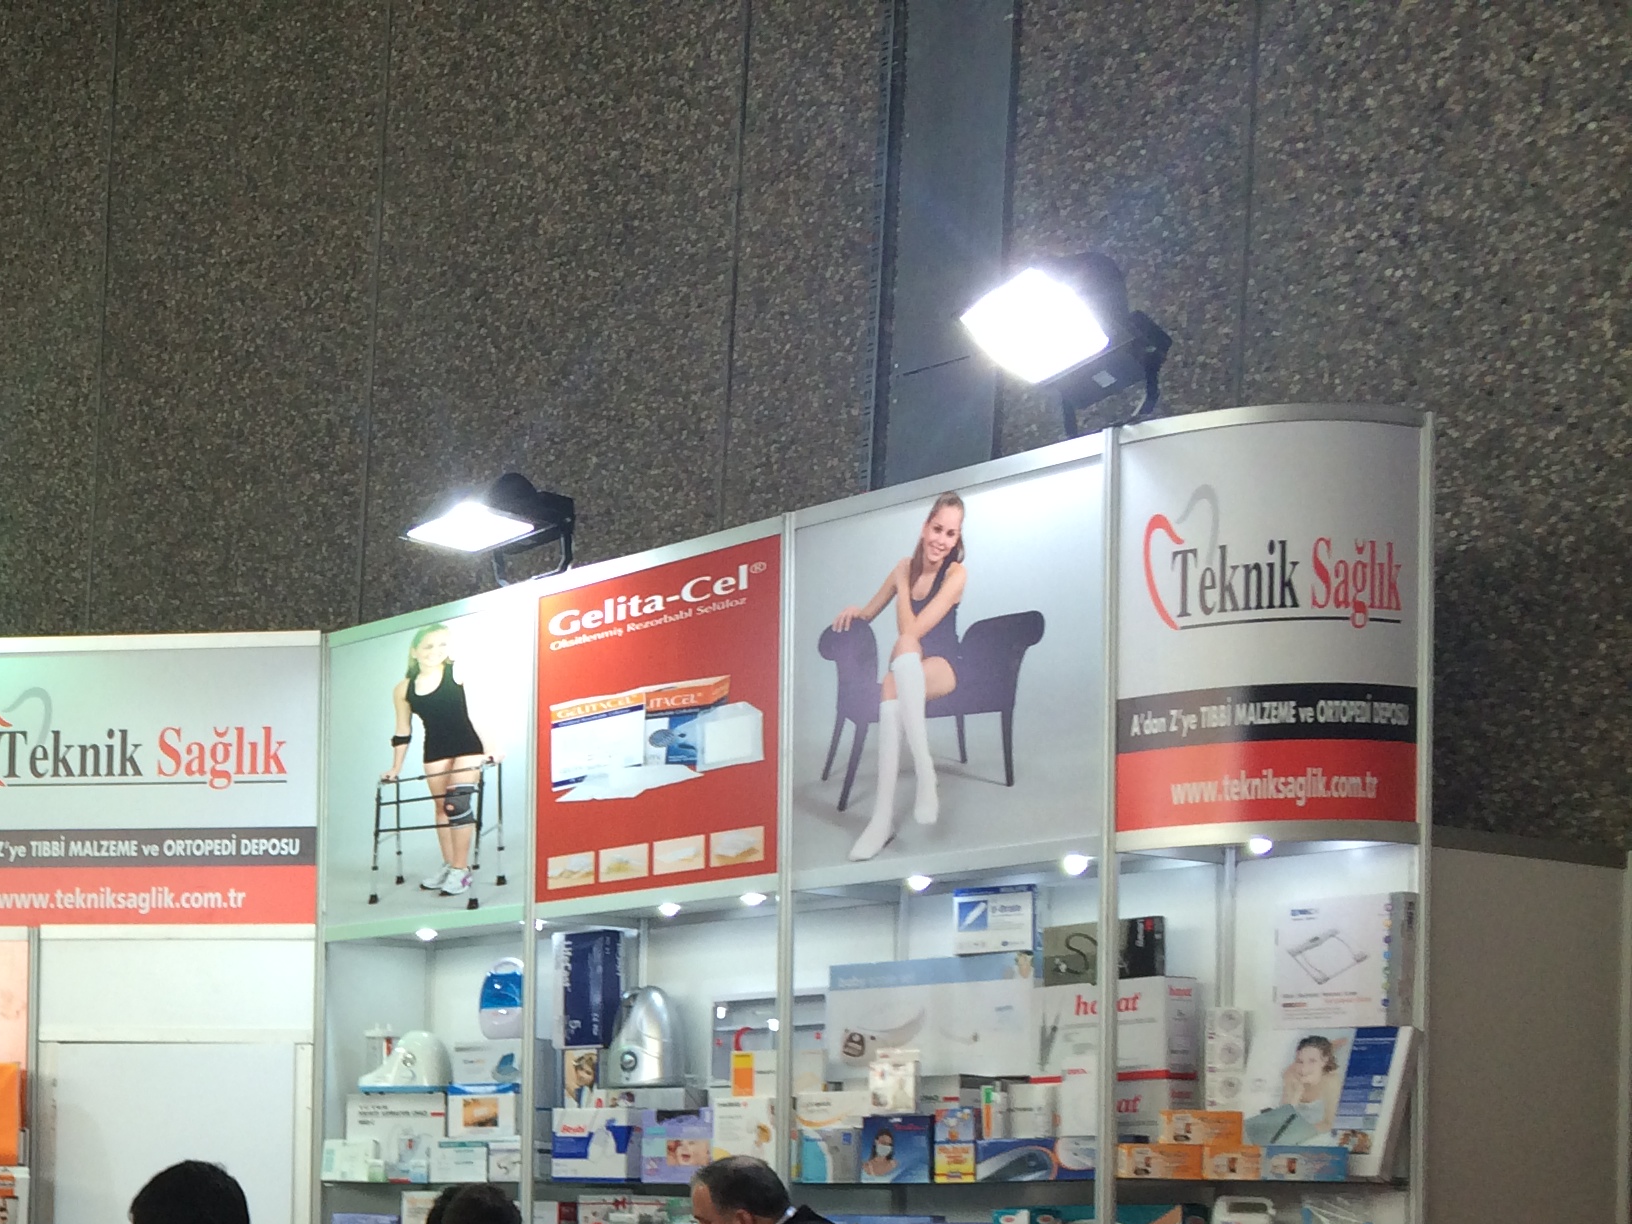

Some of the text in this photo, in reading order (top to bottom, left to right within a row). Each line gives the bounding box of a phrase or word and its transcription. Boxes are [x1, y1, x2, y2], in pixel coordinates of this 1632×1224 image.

[1172, 537, 1402, 630] Teknik Sağlık
[1234, 701, 1297, 726] MALZEME
[156, 726, 288, 790] Sağlık
[1170, 767, 1378, 806] www.tekniksaglik.com.tr
[30, 835, 65, 858] TIBBİ
[69, 840, 138, 858] MALZEME
[142, 843, 160, 857] ve
[163, 833, 237, 857] ORTOPEDİ
[240, 838, 300, 856] DEPOSU
